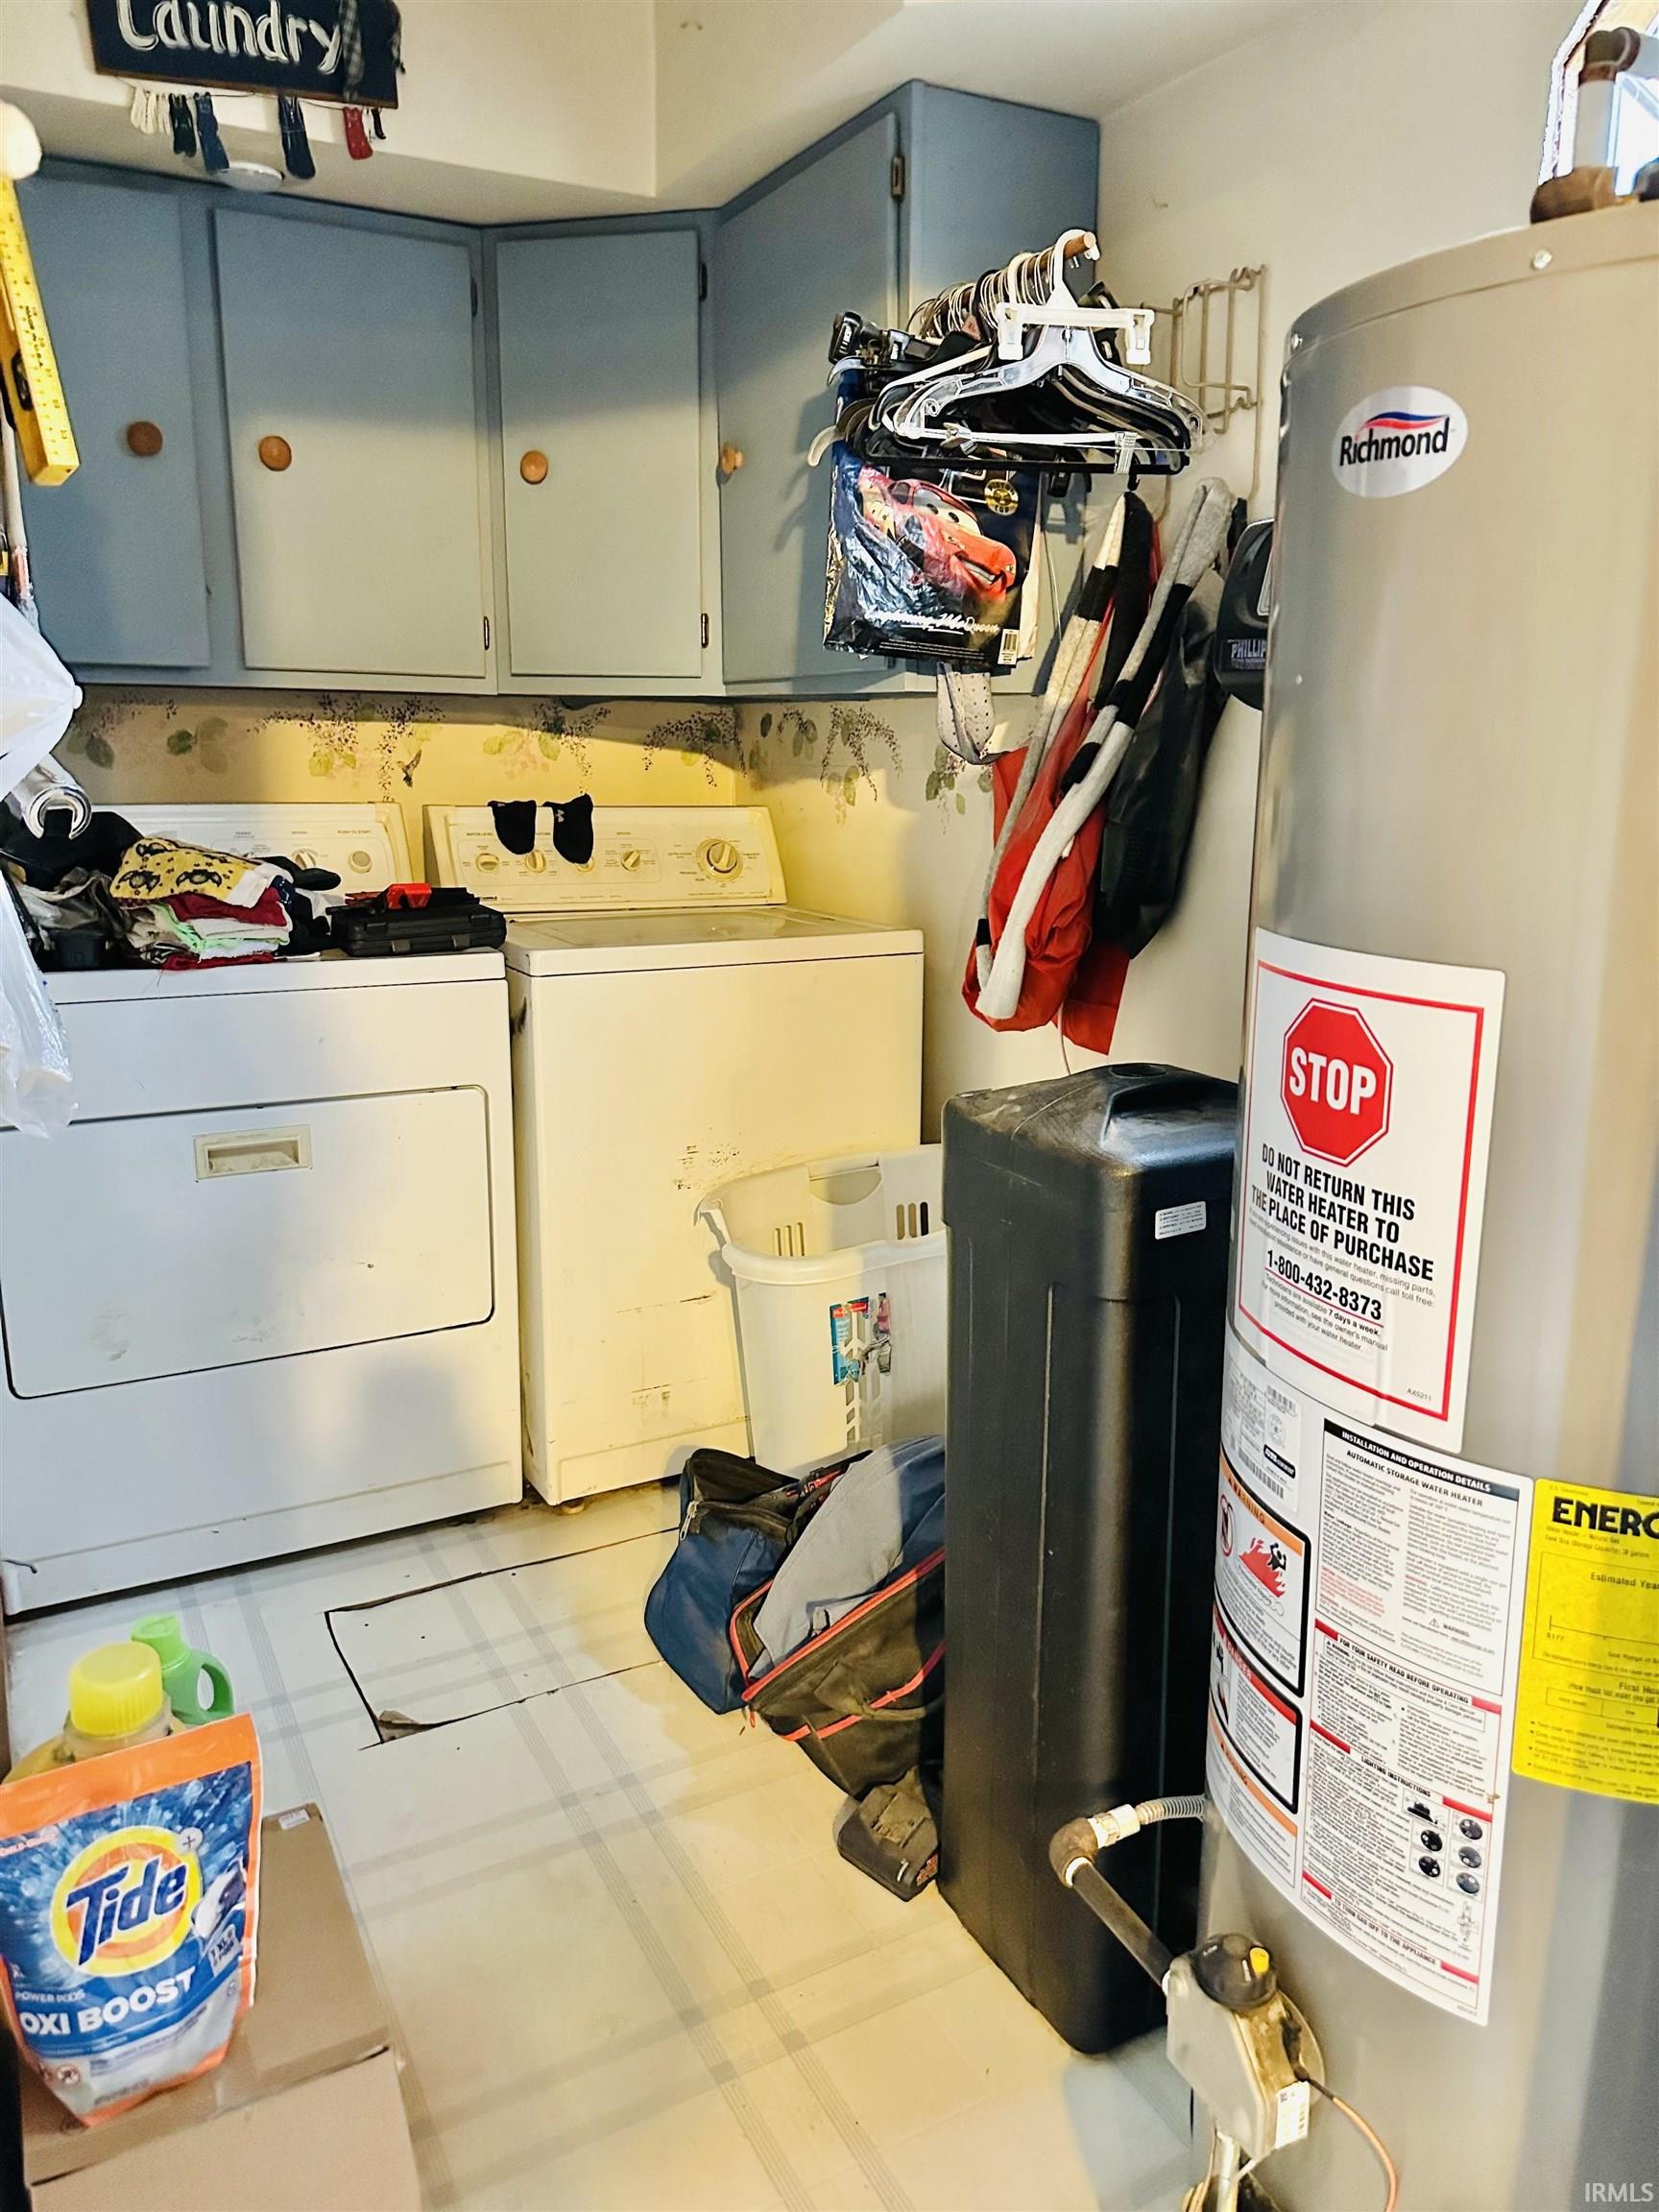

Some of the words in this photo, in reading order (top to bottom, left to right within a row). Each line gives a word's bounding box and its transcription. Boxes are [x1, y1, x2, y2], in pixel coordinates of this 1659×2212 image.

[1338, 416, 1451, 468] Richmond
[1289, 1046, 1377, 1116] STOP
[1262, 1143, 1275, 1167] DO
[1277, 1153, 1300, 1180] NOT
[1304, 1166, 1365, 1207] RETURN
[1371, 1189, 1415, 1220] THIS
[1266, 1170, 1304, 1208] WATER
[1309, 1192, 1368, 1235] HEATER
[1375, 1216, 1400, 1244] TO
[1251, 1185, 1266, 1212] THE
[1269, 1197, 1306, 1236] PLACE
[1310, 1219, 1329, 1244] OF
[1334, 1230, 1434, 1282] PURCHASE
[1267, 1249, 1382, 1320] 1-800-432-8373
[1310, 1255, 1324, 1267] have
[1325, 1262, 1348, 1278] general
[1385, 1286, 1400, 1297] call
[1402, 1290, 1414, 1302] toll
[1334, 1257, 1352, 1268] water
[1381, 1273, 1409, 1289] missing
[1321, 1328, 1338, 1341] water
[1323, 1317, 1334, 1328] the
[1361, 1335, 1388, 1351] manual
[1334, 1312, 1351, 1325] days
[1341, 1431, 1389, 1458] INSTALLATION
[1390, 1452, 1407, 1465] AND
[1407, 1460, 1454, 1482] OPERATION
[1455, 1475, 1491, 1493] DETAILS
[1347, 1450, 1384, 1473] AUTOMATIC
[1386, 1467, 1420, 1487] STORAGE
[1421, 1480, 1449, 1497] WATER
[1451, 1491, 1483, 1507] HEATER
[1590, 1572, 1636, 1587] Estimated
[1339, 1637, 1350, 1647] FOR
[1352, 1645, 1365, 1657] YOUR
[1366, 1652, 1388, 1669] SAFETY
[1389, 1665, 1405, 1677] READ
[1407, 1673, 1430, 1689] BEFORE
[1431, 1685, 1469, 1704] OPERATING
[1360, 1755, 1386, 1775] LIGHTING
[1387, 1771, 1431, 1797] INSTRUCTIONS
[65, 1856, 187, 1966] Tide
[1402, 1941, 1435, 1964] APPLIANCE
[14, 1991, 55, 2003] POWER
[19, 2010, 71, 2036] OXI
[77, 1965, 196, 2034] BOOST
